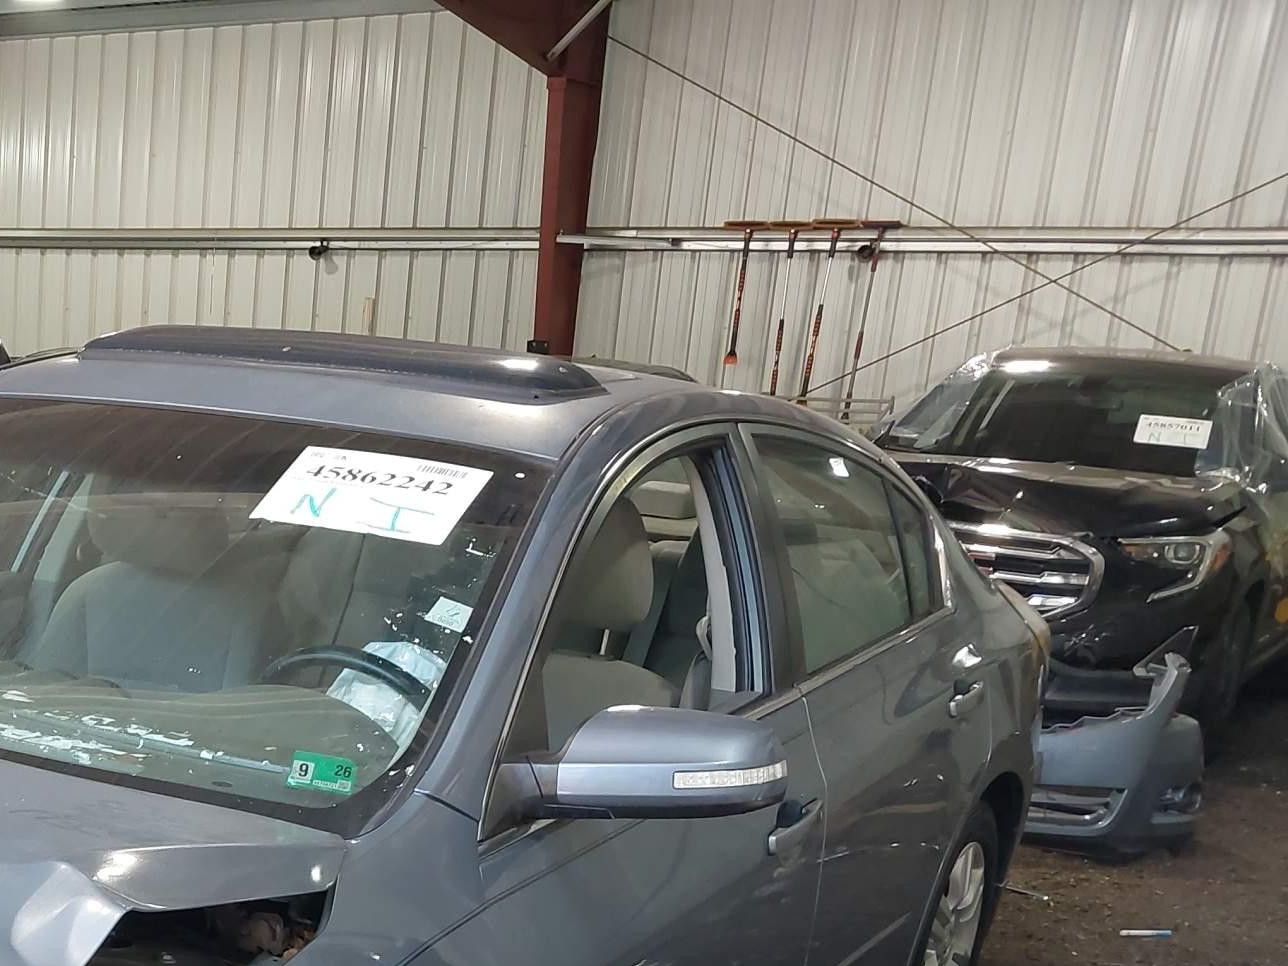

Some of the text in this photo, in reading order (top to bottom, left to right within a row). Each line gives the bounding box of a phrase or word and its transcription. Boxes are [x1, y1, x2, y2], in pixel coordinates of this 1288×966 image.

[306, 464, 454, 496] 45862242
[290, 487, 337, 518] N
[298, 763, 352, 778] 9 26
